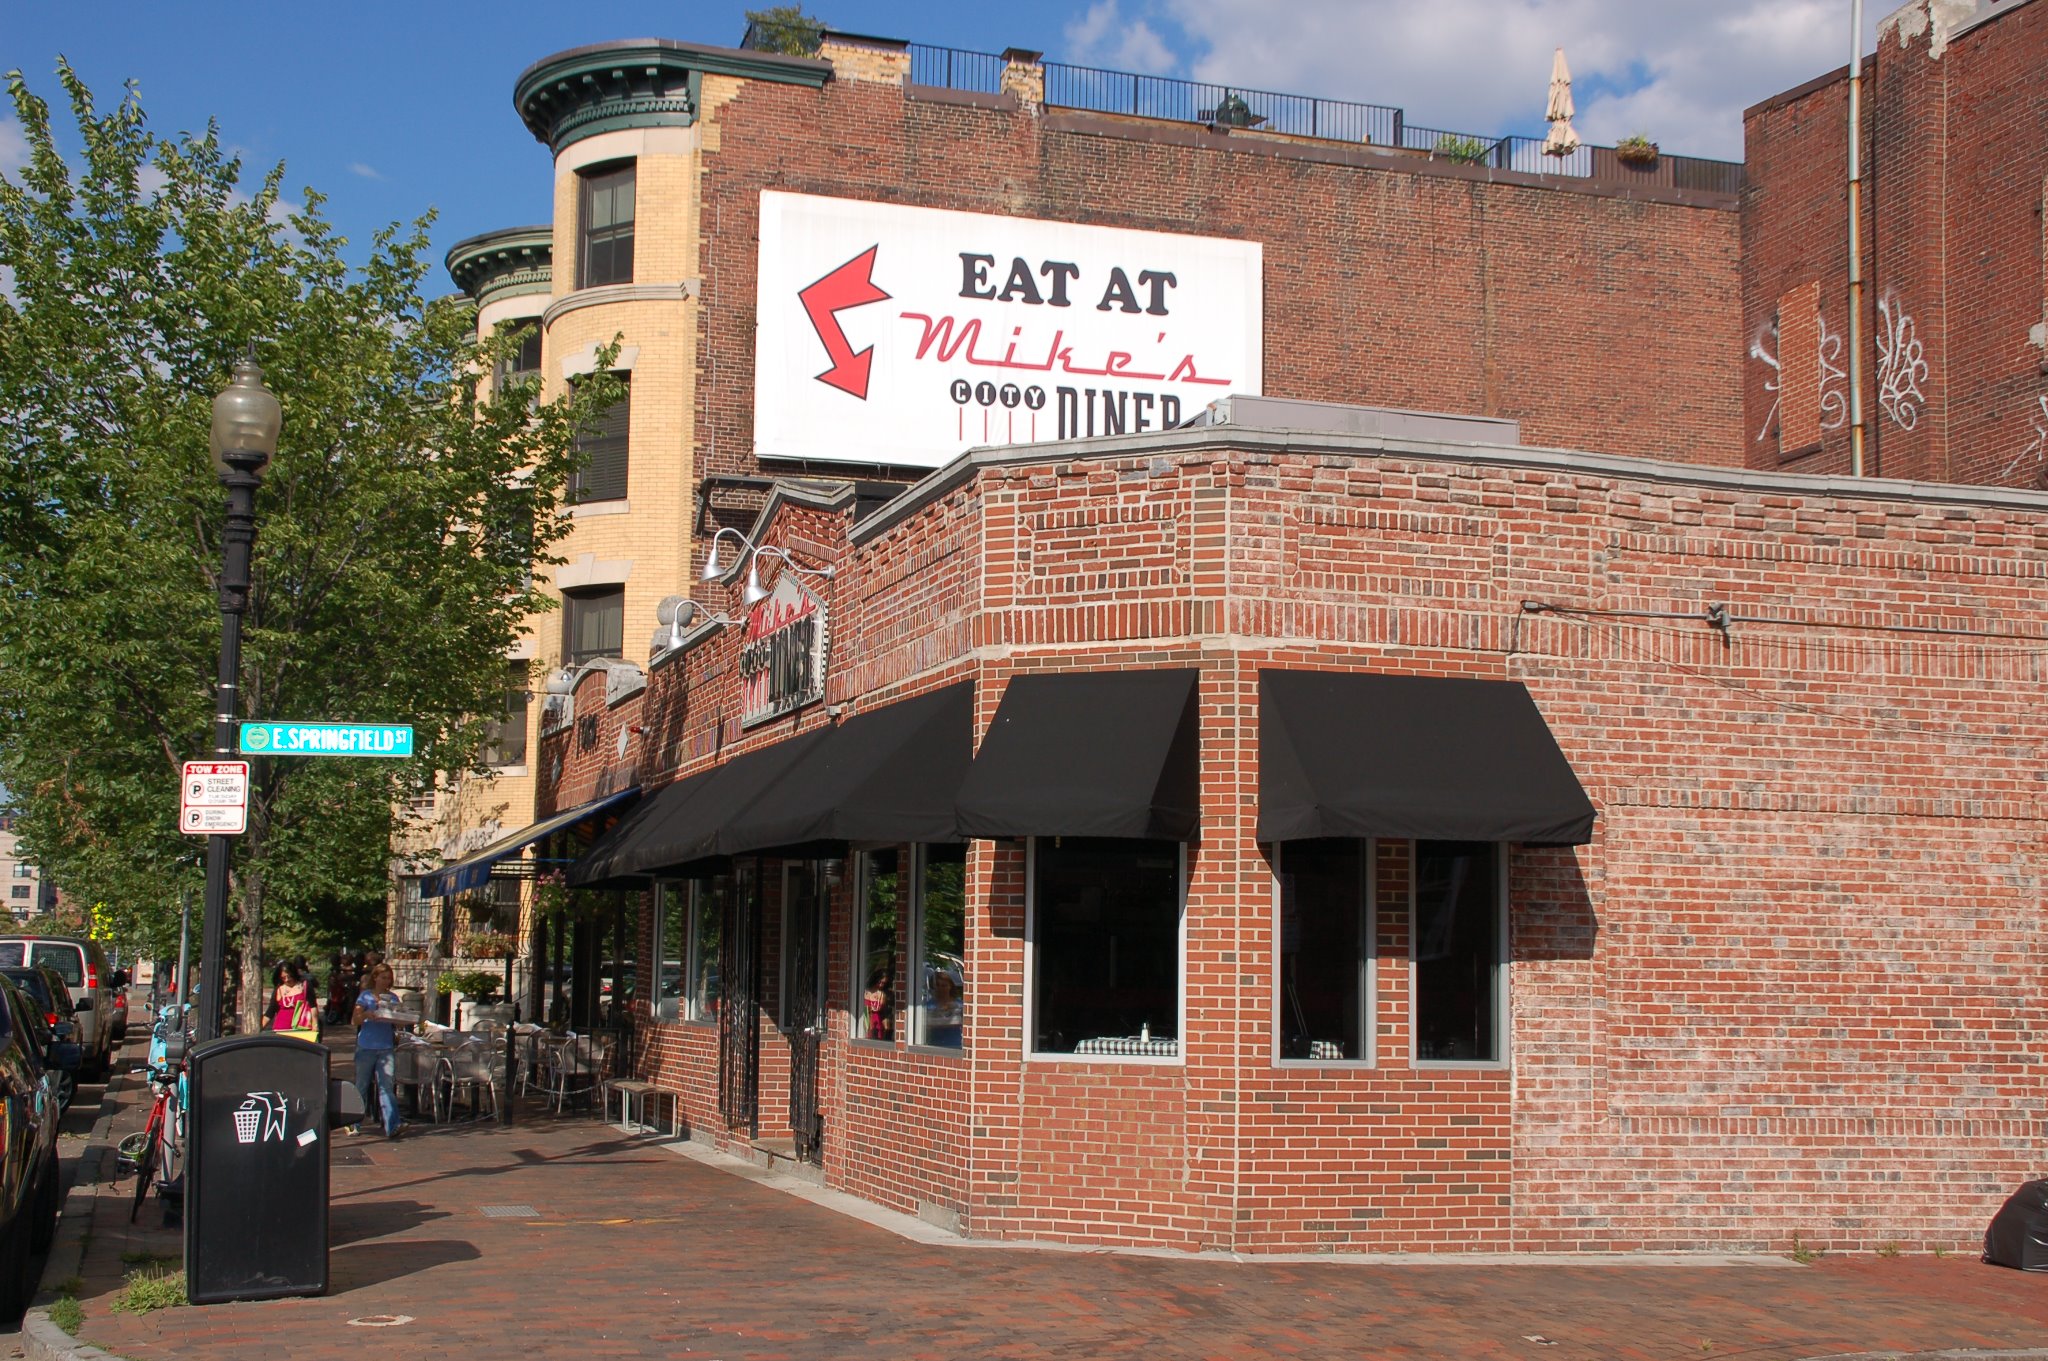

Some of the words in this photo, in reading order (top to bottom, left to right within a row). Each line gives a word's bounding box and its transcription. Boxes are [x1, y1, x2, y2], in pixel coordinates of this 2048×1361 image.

[958, 252, 1080, 307] EAT
[1096, 266, 1178, 316] AT
[900, 311, 1232, 386] Mike's
[952, 380, 1043, 409] CITY
[395, 730, 407, 744] ST
[190, 765, 213, 773] TOW
[216, 765, 243, 774] ZONE
